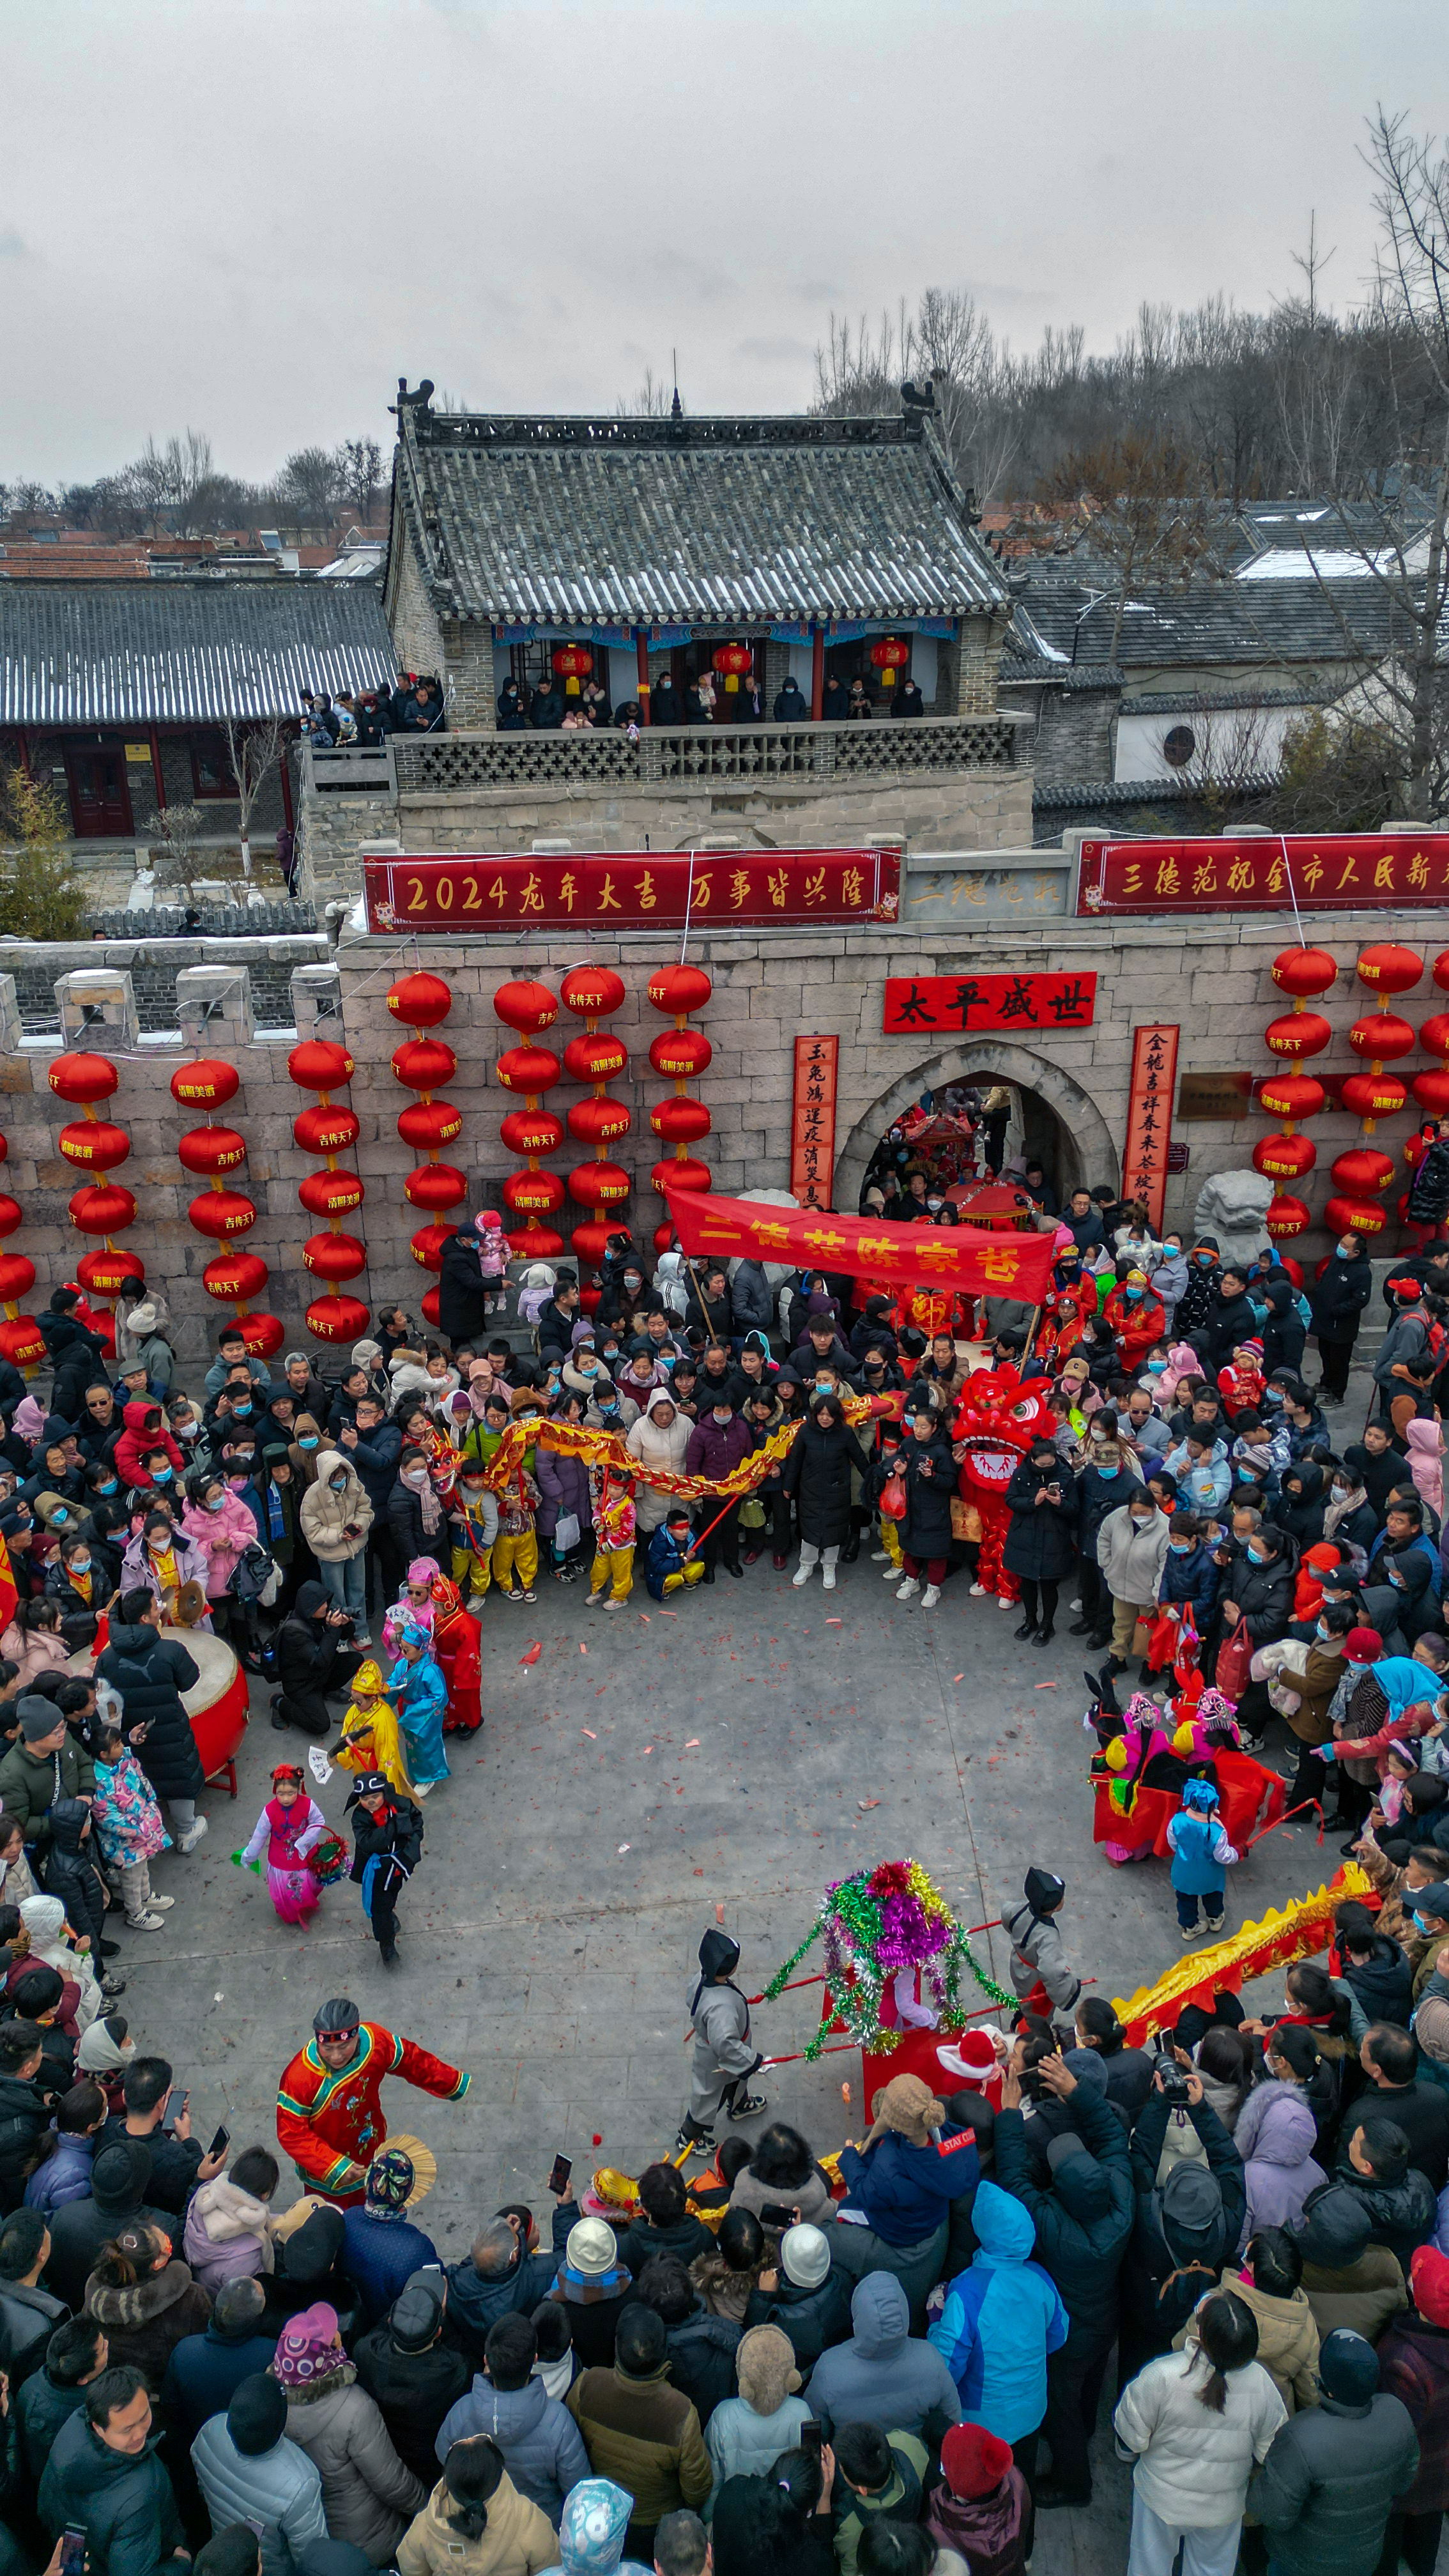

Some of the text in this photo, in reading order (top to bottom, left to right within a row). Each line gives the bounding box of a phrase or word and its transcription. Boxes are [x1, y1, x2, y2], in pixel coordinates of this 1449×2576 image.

[407, 866, 865, 914] 2024龙年大吉 万事皆兴隆
[569, 993, 602, 1006] 吉传天下
[893, 978, 1091, 1029] 太平盛世
[1269, 1037, 1302, 1051] 吉传天下
[319, 1128, 352, 1146] 吉传天下
[523, 1133, 555, 1148] 吉传天下
[226, 1211, 254, 1229] 吉传天下
[1268, 1221, 1302, 1234] 吉传天下
[208, 1280, 240, 1293] 吉传天下
[307, 1316, 335, 1335] 吉传天下
[944, 2136, 962, 2151] STAY
